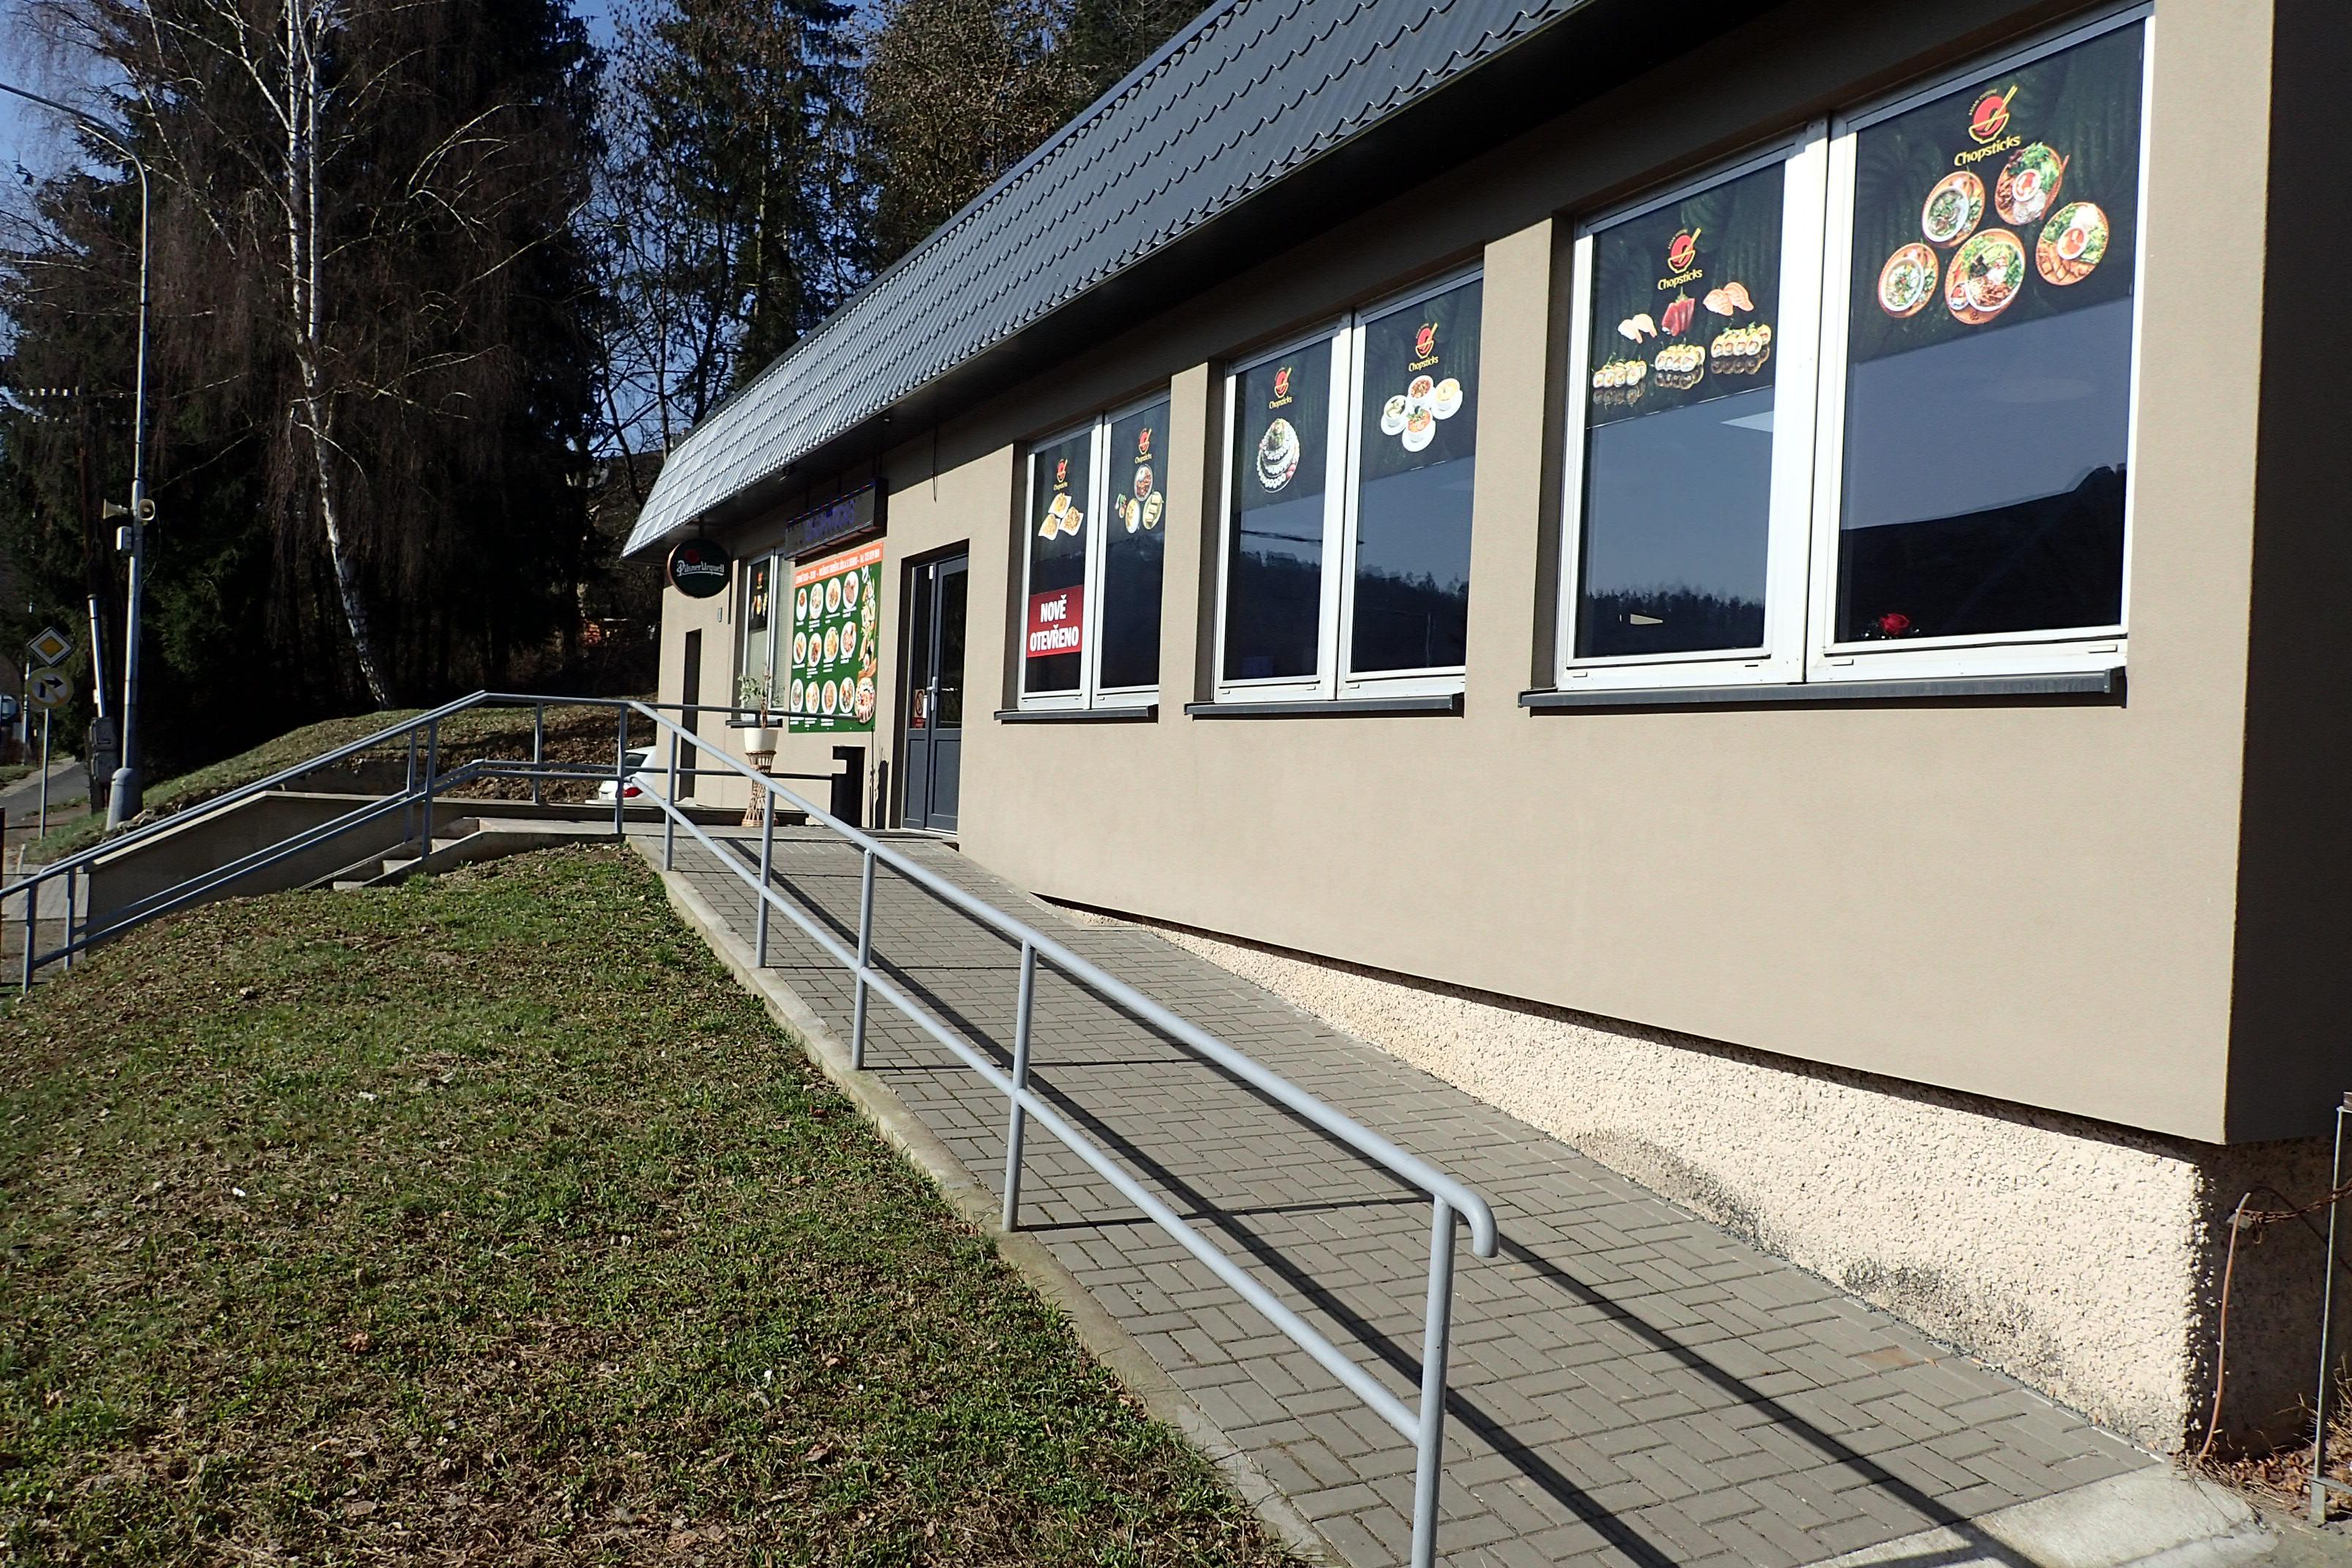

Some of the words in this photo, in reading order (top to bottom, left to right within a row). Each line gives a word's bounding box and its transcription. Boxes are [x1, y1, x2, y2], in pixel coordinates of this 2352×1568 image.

[1954, 135, 2021, 166] Chopsticks
[1657, 269, 1703, 290] Chopsticks
[1408, 355, 1439, 372] Chopsticks
[1269, 396, 1292, 409] Chopsticks
[676, 560, 701, 576] Pilsner
[701, 561, 725, 576] Urquell
[1040, 594, 1067, 623] NOVĚ
[1029, 624, 1079, 652] OTEVŘENO
